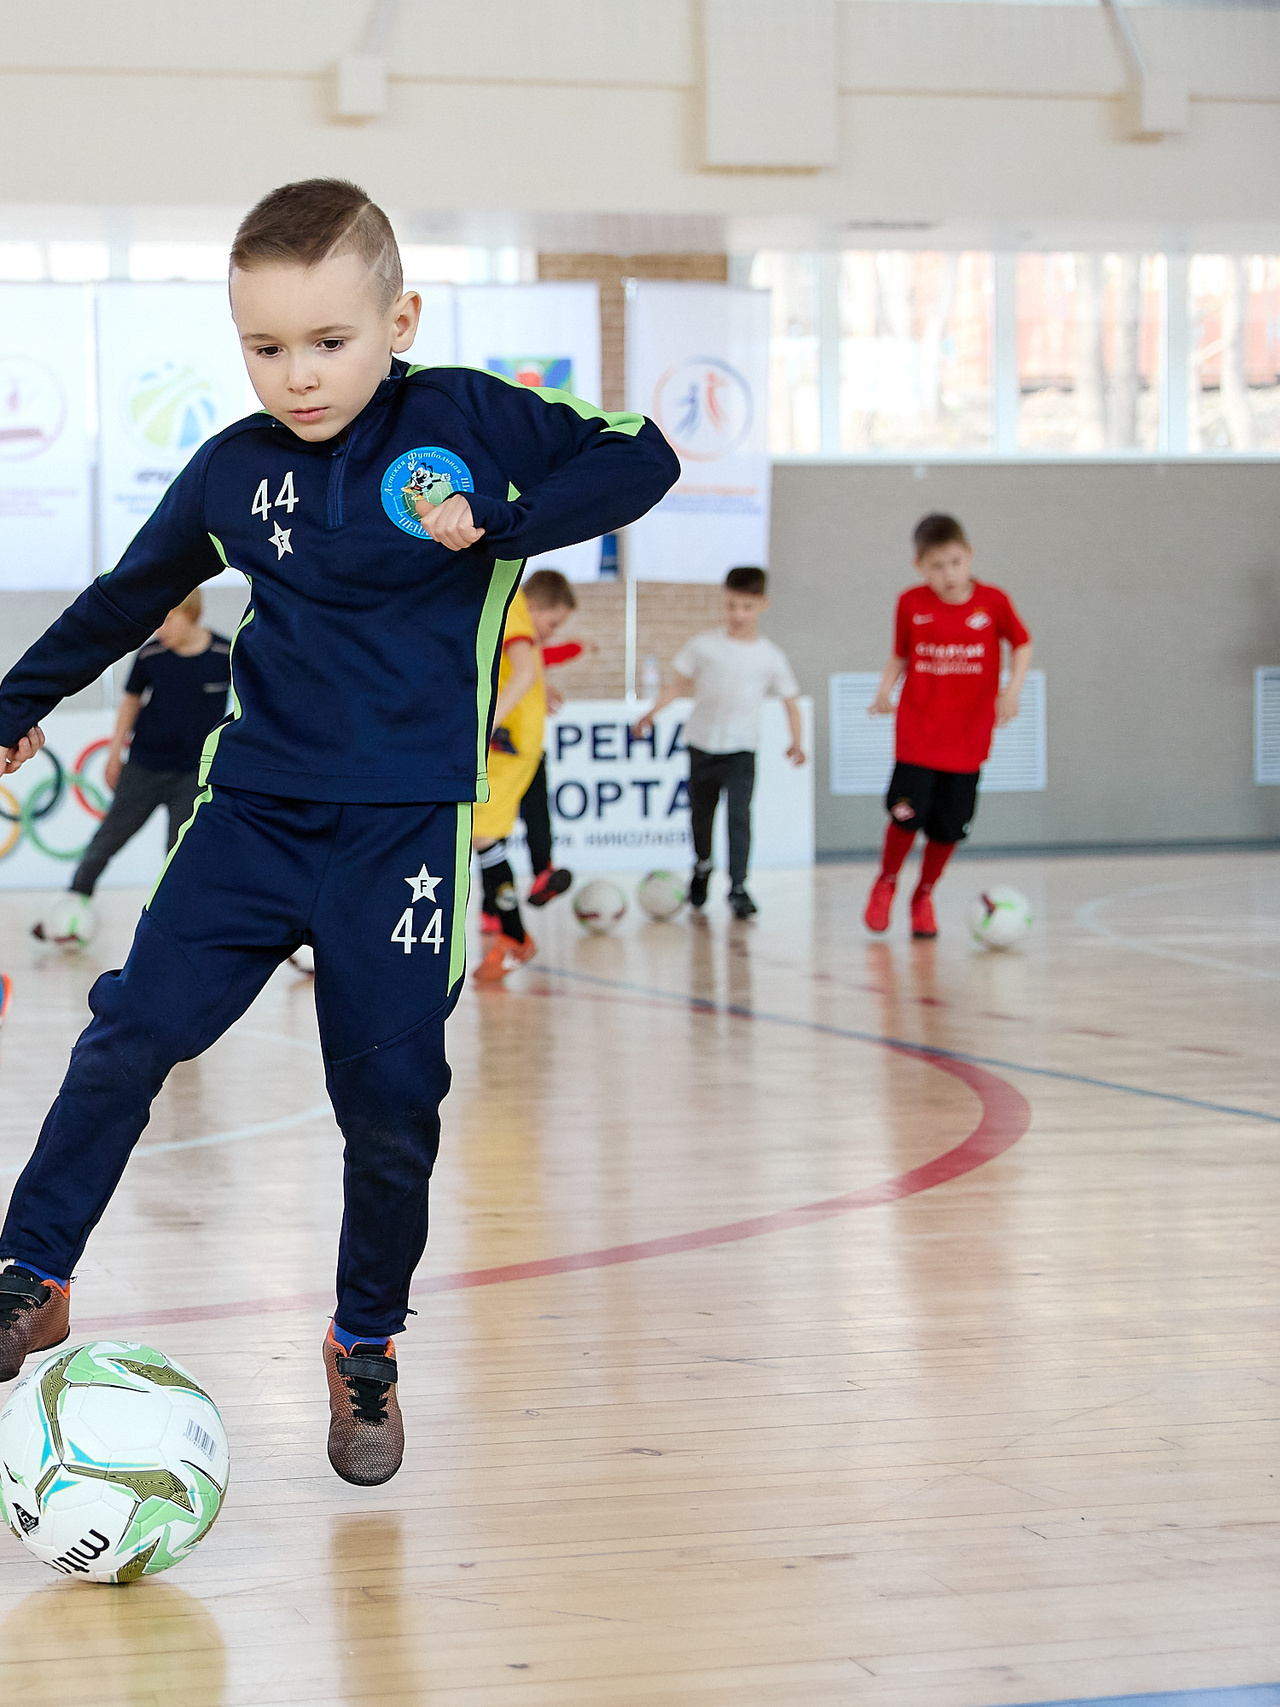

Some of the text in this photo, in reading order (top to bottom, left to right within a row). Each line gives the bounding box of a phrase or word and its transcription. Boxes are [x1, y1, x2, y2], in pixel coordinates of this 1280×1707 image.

[251, 470, 300, 521] 44
[277, 534, 286, 549] F
[419, 879, 429, 894] F
[390, 907, 445, 955] 44
